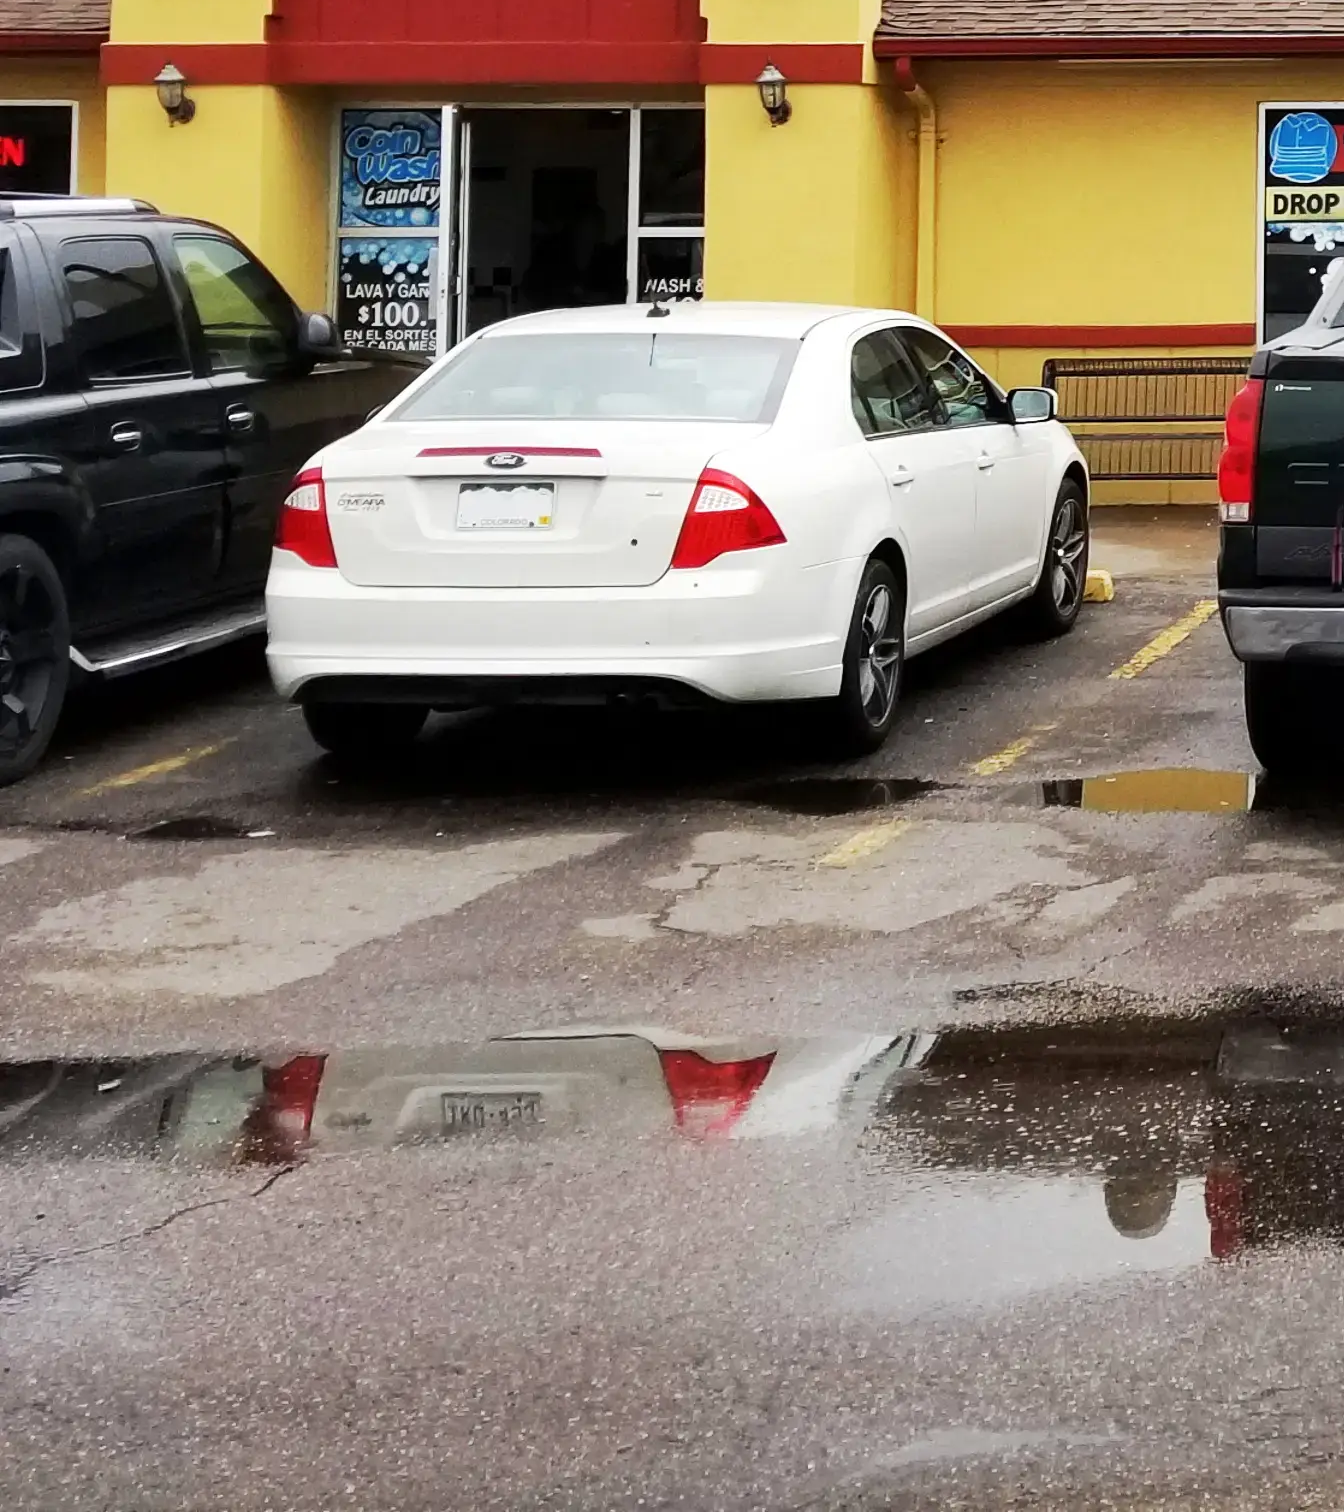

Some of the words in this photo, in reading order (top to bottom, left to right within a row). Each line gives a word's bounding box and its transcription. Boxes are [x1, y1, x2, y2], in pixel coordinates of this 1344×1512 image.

[345, 124, 421, 158] Coin
[357, 149, 440, 185] Wash
[364, 183, 440, 206] Laundry
[1273, 193, 1340, 216] DROP
[345, 283, 383, 298] LAVA
[386, 283, 395, 298] Y
[357, 301, 427, 327] $100.
[344, 329, 362, 341] EN
[366, 329, 382, 341] EL
[409, 340, 436, 351] MES
